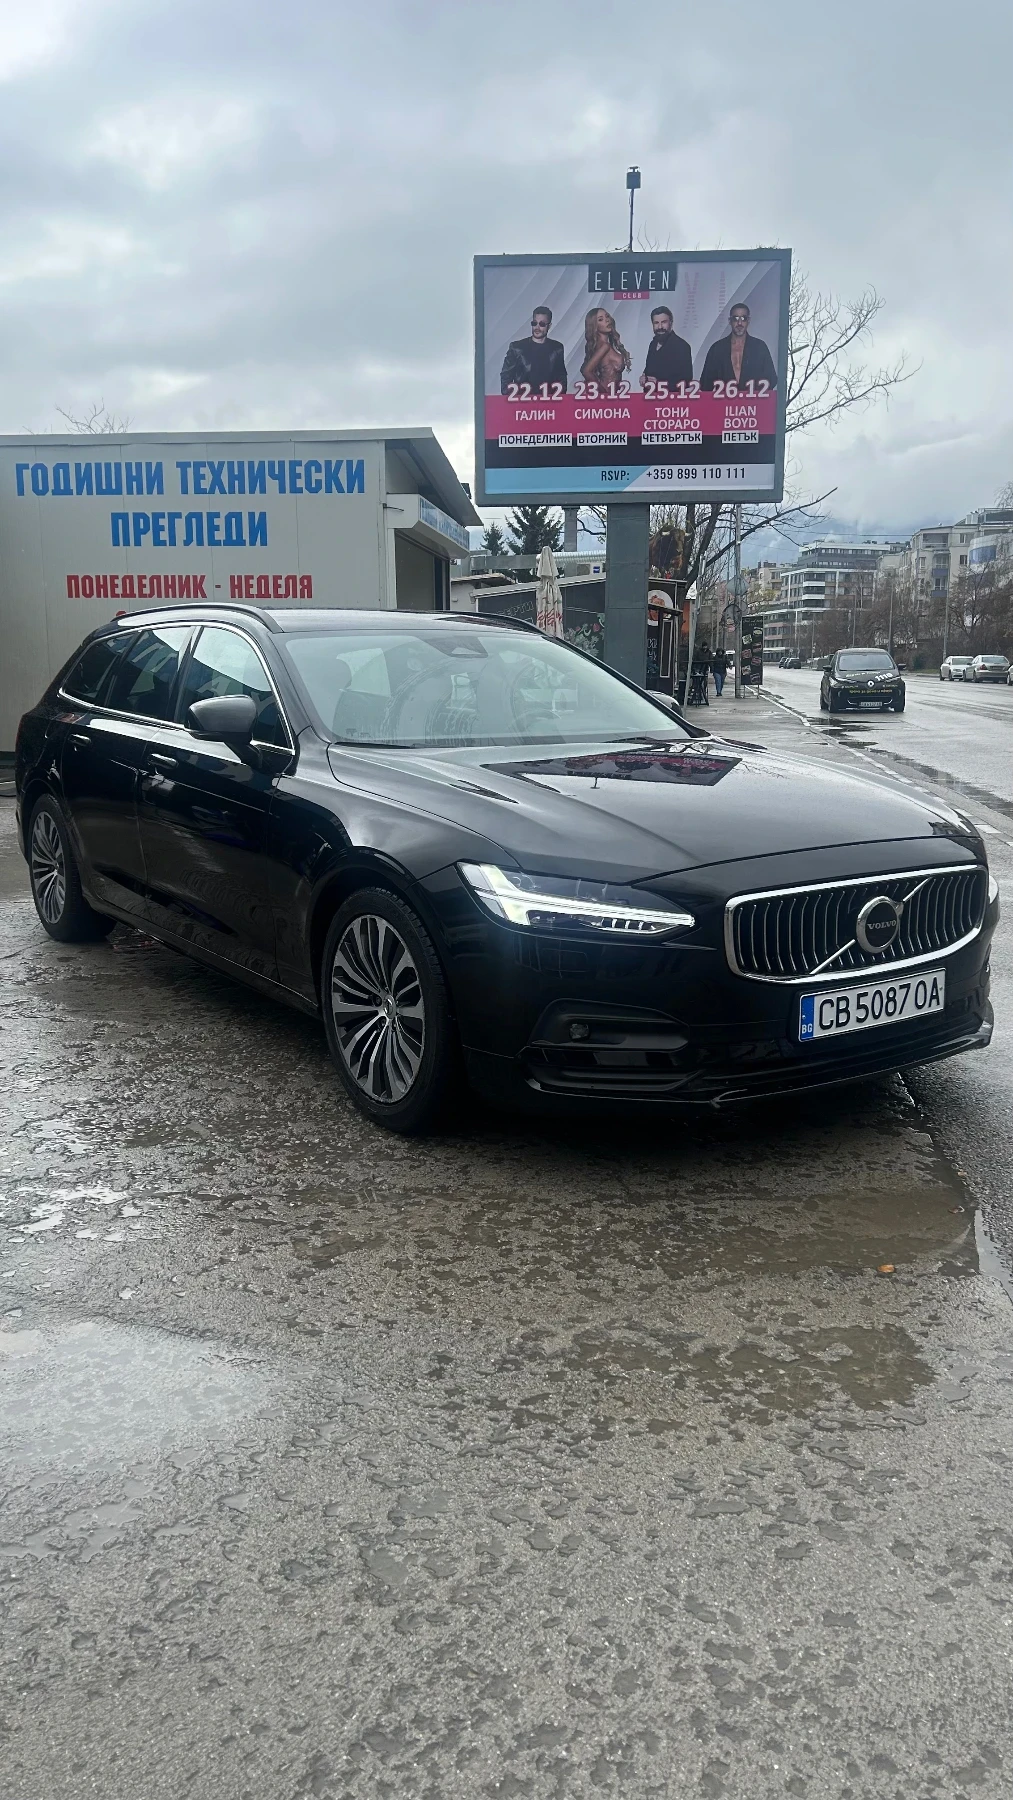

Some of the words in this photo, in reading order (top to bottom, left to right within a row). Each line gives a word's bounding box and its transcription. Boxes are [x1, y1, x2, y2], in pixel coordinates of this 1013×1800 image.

[594, 270, 670, 291] ELEVEN
[507, 382, 563, 402] 22.12
[574, 381, 631, 400] 23.12
[644, 380, 700, 400] 25.12
[713, 379, 770, 398] 26.12
[515, 410, 556, 421] ГАЛИН
[574, 408, 631, 420] СИМОНА
[655, 407, 689, 418] ТОНИ
[725, 405, 757, 417] ILIAN
[643, 418, 700, 430] СТОРАРО
[723, 417, 758, 429] BOYD
[500, 434, 571, 446] ПОНЕДЕЛНИК
[578, 433, 627, 444] ВТОРНИК
[642, 432, 701, 443] ЧЕТВЪРТЪК
[724, 431, 757, 442] ПЕТЪК
[15, 462, 164, 496] ГОДИШНИ
[176, 459, 365, 495] ТЕХНИЧЕСКИ
[601, 470, 630, 481] RSVP:
[646, 468, 673, 480] +359
[677, 468, 697, 479] 899
[702, 467, 722, 479] 110
[726, 467, 746, 478] 111
[111, 512, 268, 547] ПРЕГЛЕДИ
[66, 574, 207, 599] ПОНЕДЕЛНИК
[229, 574, 313, 599] НЕДЕЛЯ
[867, 920, 897, 930] VOLVO
[801, 1023, 813, 1034] BG
